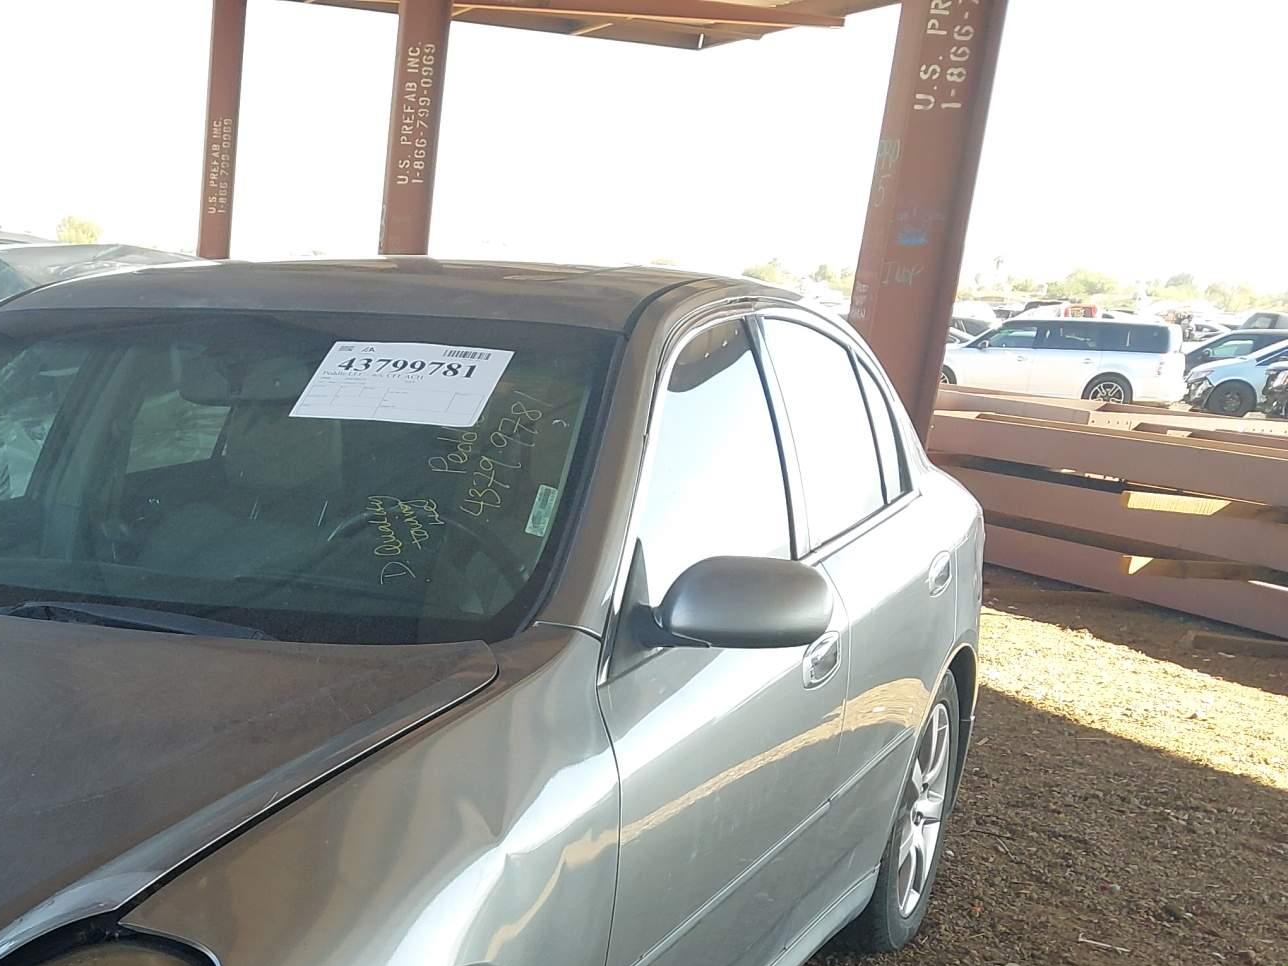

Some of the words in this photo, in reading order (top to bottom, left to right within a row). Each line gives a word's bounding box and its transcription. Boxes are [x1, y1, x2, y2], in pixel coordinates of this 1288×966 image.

[407, 41, 423, 73] INC.
[940, 0, 979, 109] 1-866-
[913, 56, 942, 110] U.S.
[400, 81, 418, 145] PREFAB
[412, 43, 436, 183] 1-866-799-0969
[210, 143, 221, 187] PREFAB
[396, 154, 412, 184] U.S.
[337, 357, 477, 379] 43799781
